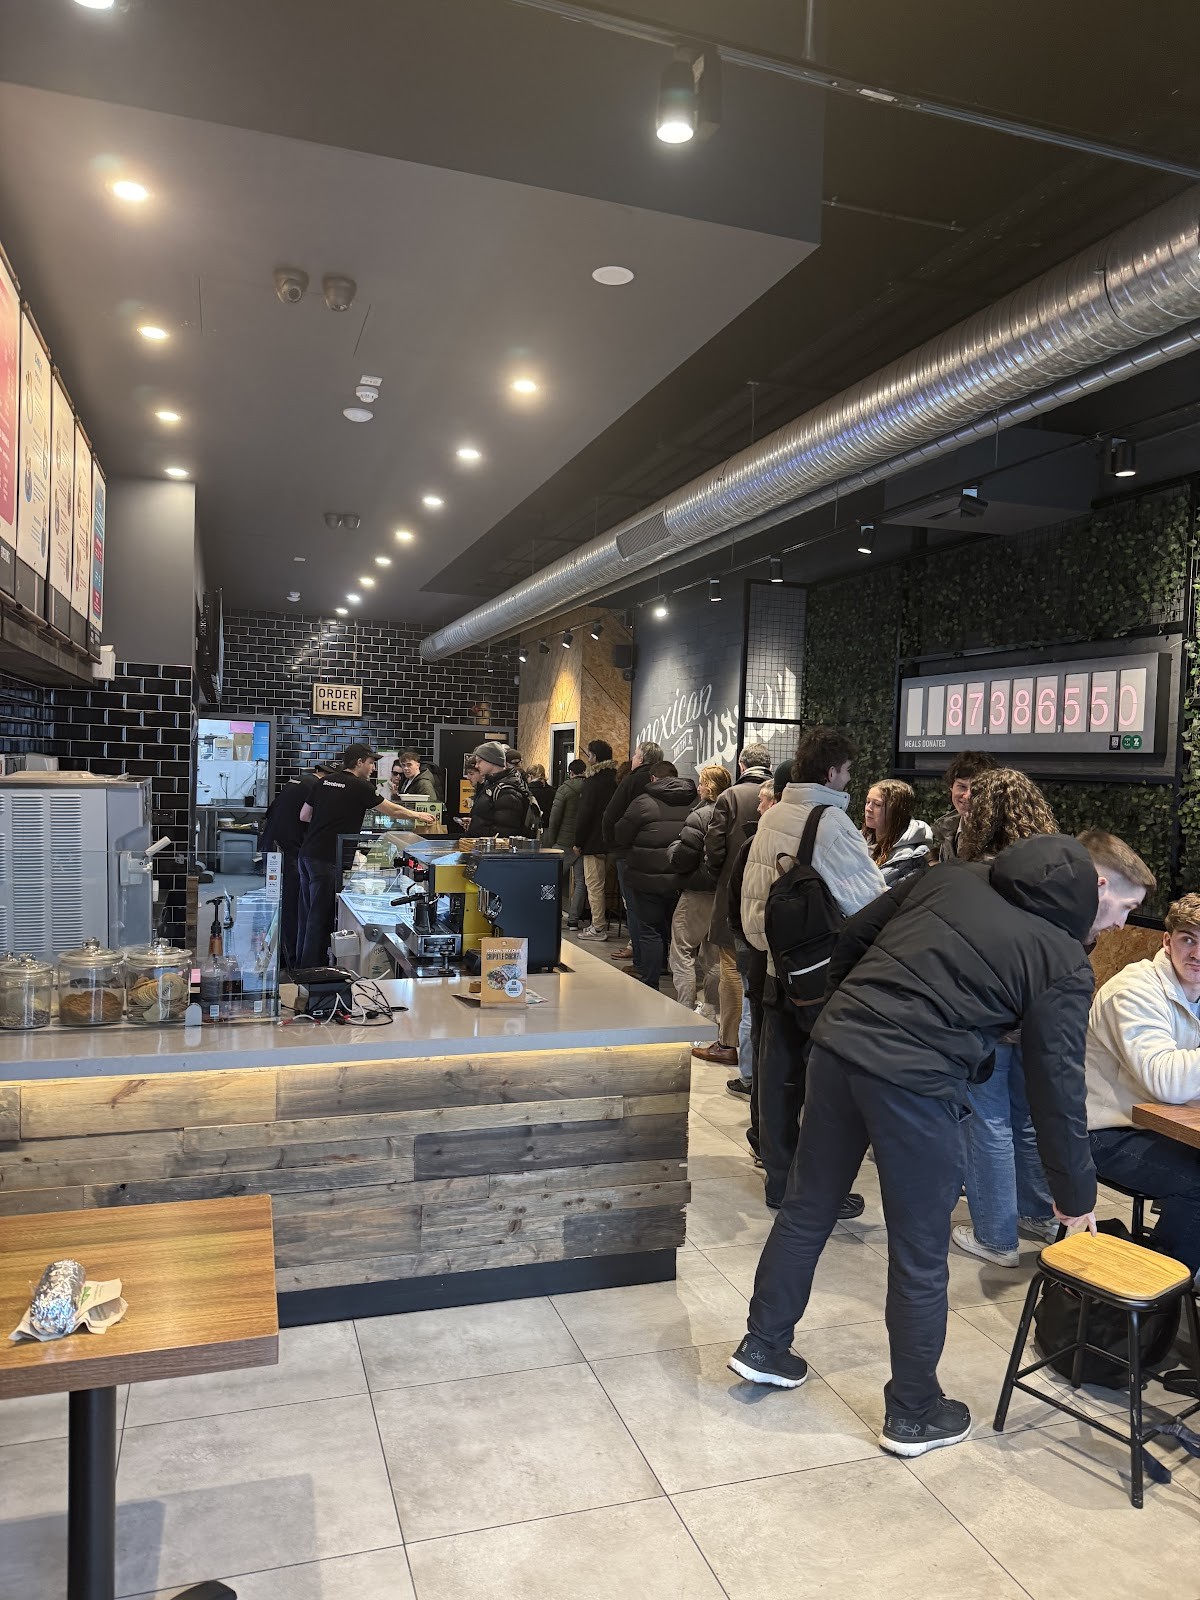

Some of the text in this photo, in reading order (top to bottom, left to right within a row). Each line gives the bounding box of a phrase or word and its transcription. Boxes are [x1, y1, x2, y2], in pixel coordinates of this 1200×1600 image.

[318, 688, 357, 700] ORDER
[322, 700, 354, 711] HERE
[904, 740, 946, 748] MEALS DONATED
